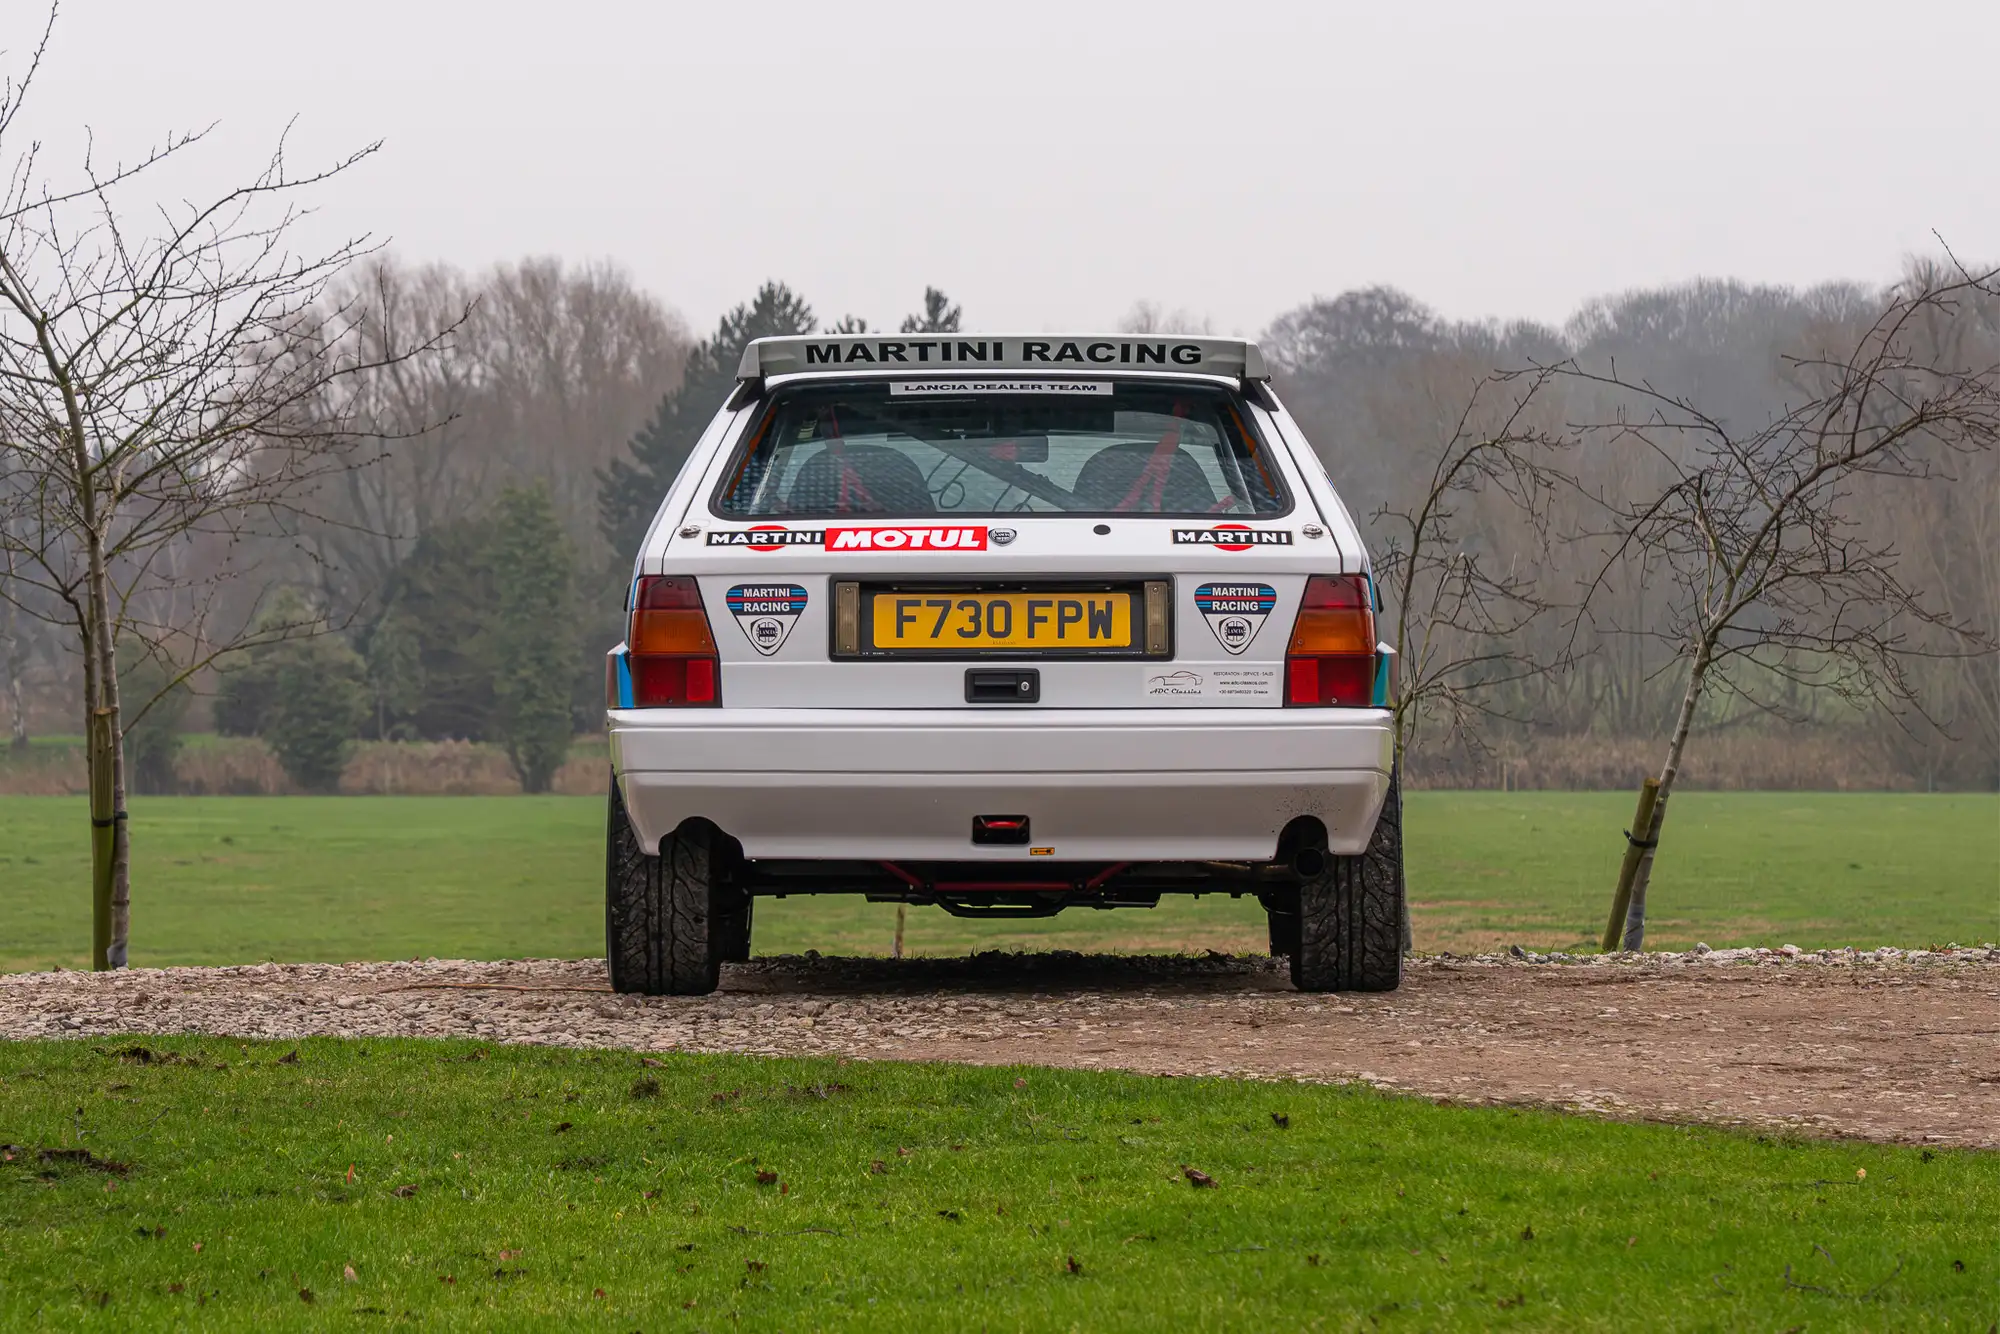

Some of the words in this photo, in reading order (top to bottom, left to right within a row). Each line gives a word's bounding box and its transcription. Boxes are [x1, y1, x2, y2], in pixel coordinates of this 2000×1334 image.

[804, 342, 1004, 365] MARTINI
[1022, 341, 1202, 365] RACING
[904, 384, 969, 392] LANCIA
[972, 383, 1043, 392] DEALER
[1046, 384, 1098, 392] TEAM
[711, 531, 821, 545] MARTINI
[832, 528, 982, 549] MOTUL
[1177, 531, 1288, 544] MARTINI
[743, 588, 790, 597] MARTINI
[1212, 587, 1259, 597] MARTINI
[743, 602, 790, 612] RACING
[1212, 601, 1259, 611] RACING
[895, 599, 1012, 639] F730
[1027, 600, 1113, 639] FPW
[1171, 687, 1202, 695] Classics
